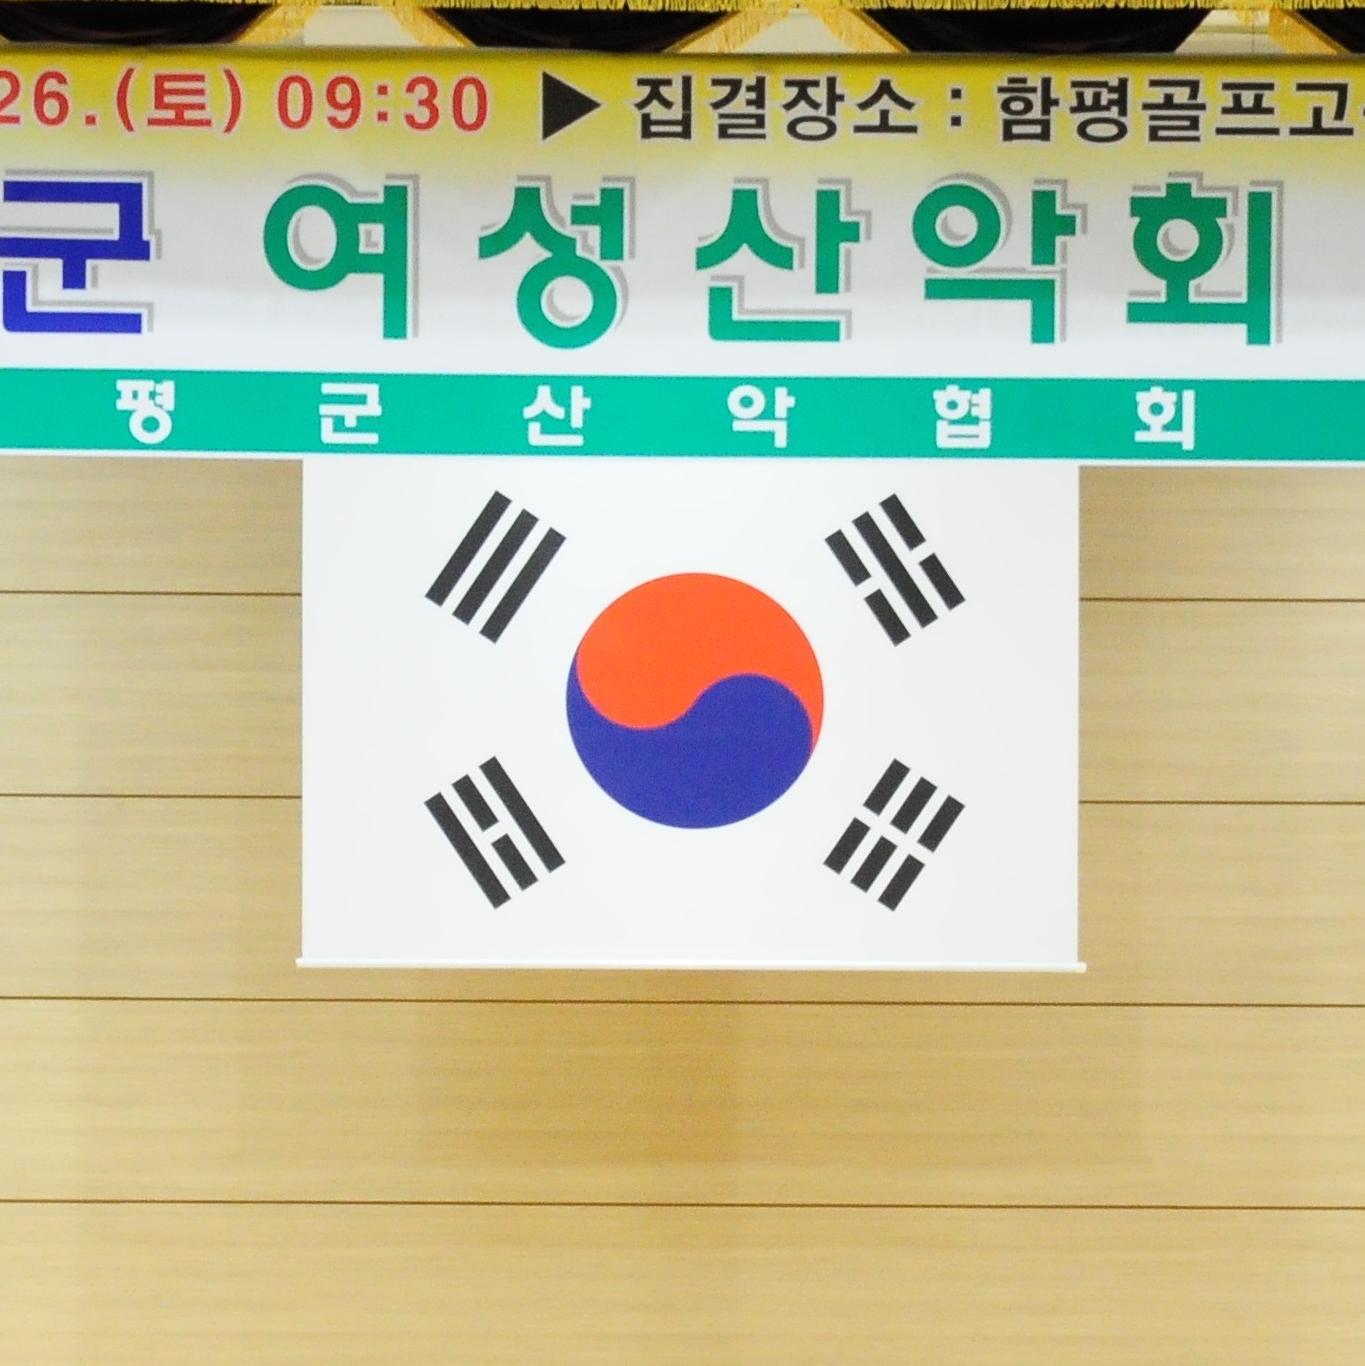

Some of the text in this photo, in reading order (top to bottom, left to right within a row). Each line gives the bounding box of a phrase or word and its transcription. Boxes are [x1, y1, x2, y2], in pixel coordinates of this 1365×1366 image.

[277, 74, 488, 132] 09:30
[634, 75, 919, 142] 집결장소
[263, 181, 1279, 351] 여성산악회
